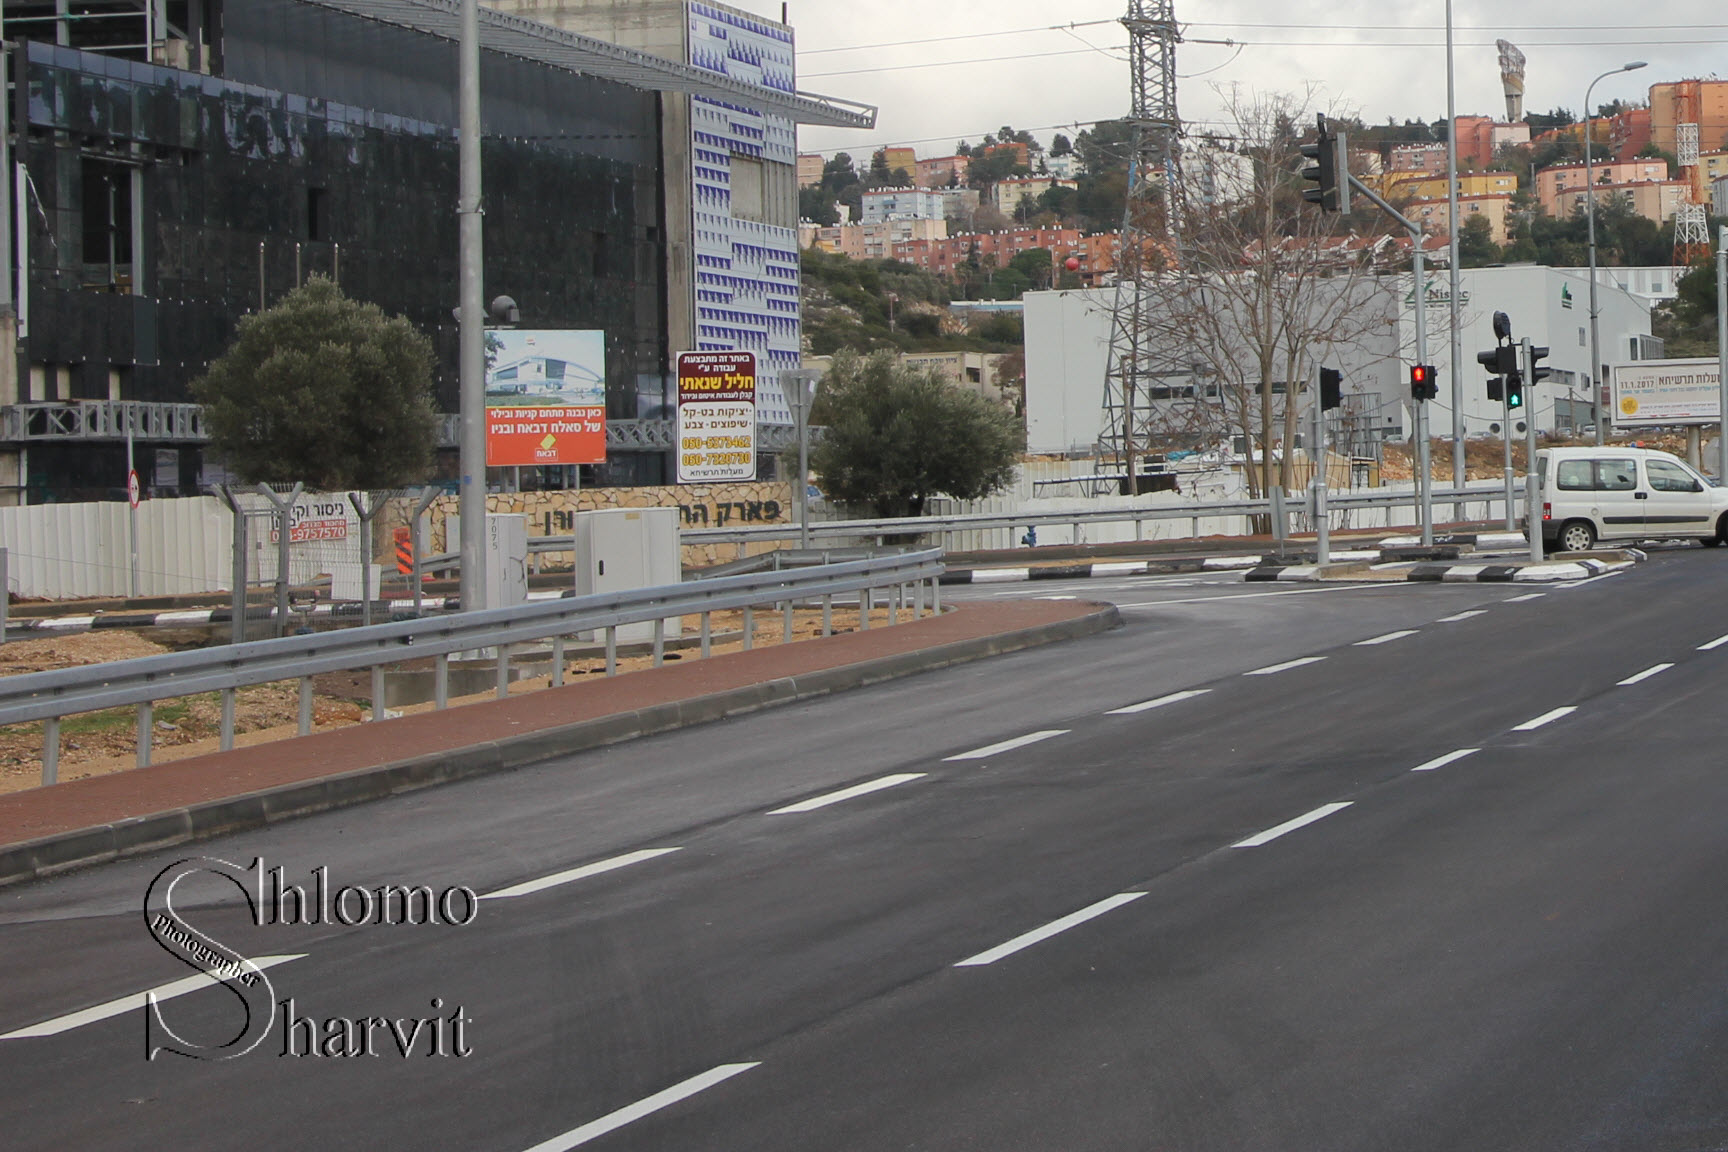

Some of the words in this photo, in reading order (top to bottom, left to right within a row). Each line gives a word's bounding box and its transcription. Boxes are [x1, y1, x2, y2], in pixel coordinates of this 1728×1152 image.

[1429, 289, 1469, 299] Nisc
[683, 355, 718, 364] מתבצעת
[719, 355, 728, 363] זה
[729, 354, 750, 362] באתר
[713, 364, 737, 372] עבודה
[680, 376, 722, 390] שנאתי
[725, 373, 754, 389] חליל
[1620, 380, 1654, 389] 11.1.2017
[1658, 375, 1694, 386] תרשיחא
[491, 408, 513, 418] ובילוי
[515, 409, 538, 420] קניות
[539, 409, 565, 418] מתחם
[566, 409, 586, 418] נבנה
[587, 409, 602, 419] כאן
[517, 423, 548, 433] דבאח
[551, 420, 582, 433] סאלח
[584, 420, 601, 432] של
[685, 421, 704, 429] צבע
[711, 420, 748, 428] שיפוצים
[690, 469, 719, 477] תרשיחא
[720, 467, 744, 476] מעלות
[313, 503, 344, 517] ניסור
[717, 500, 781, 527] פארק
